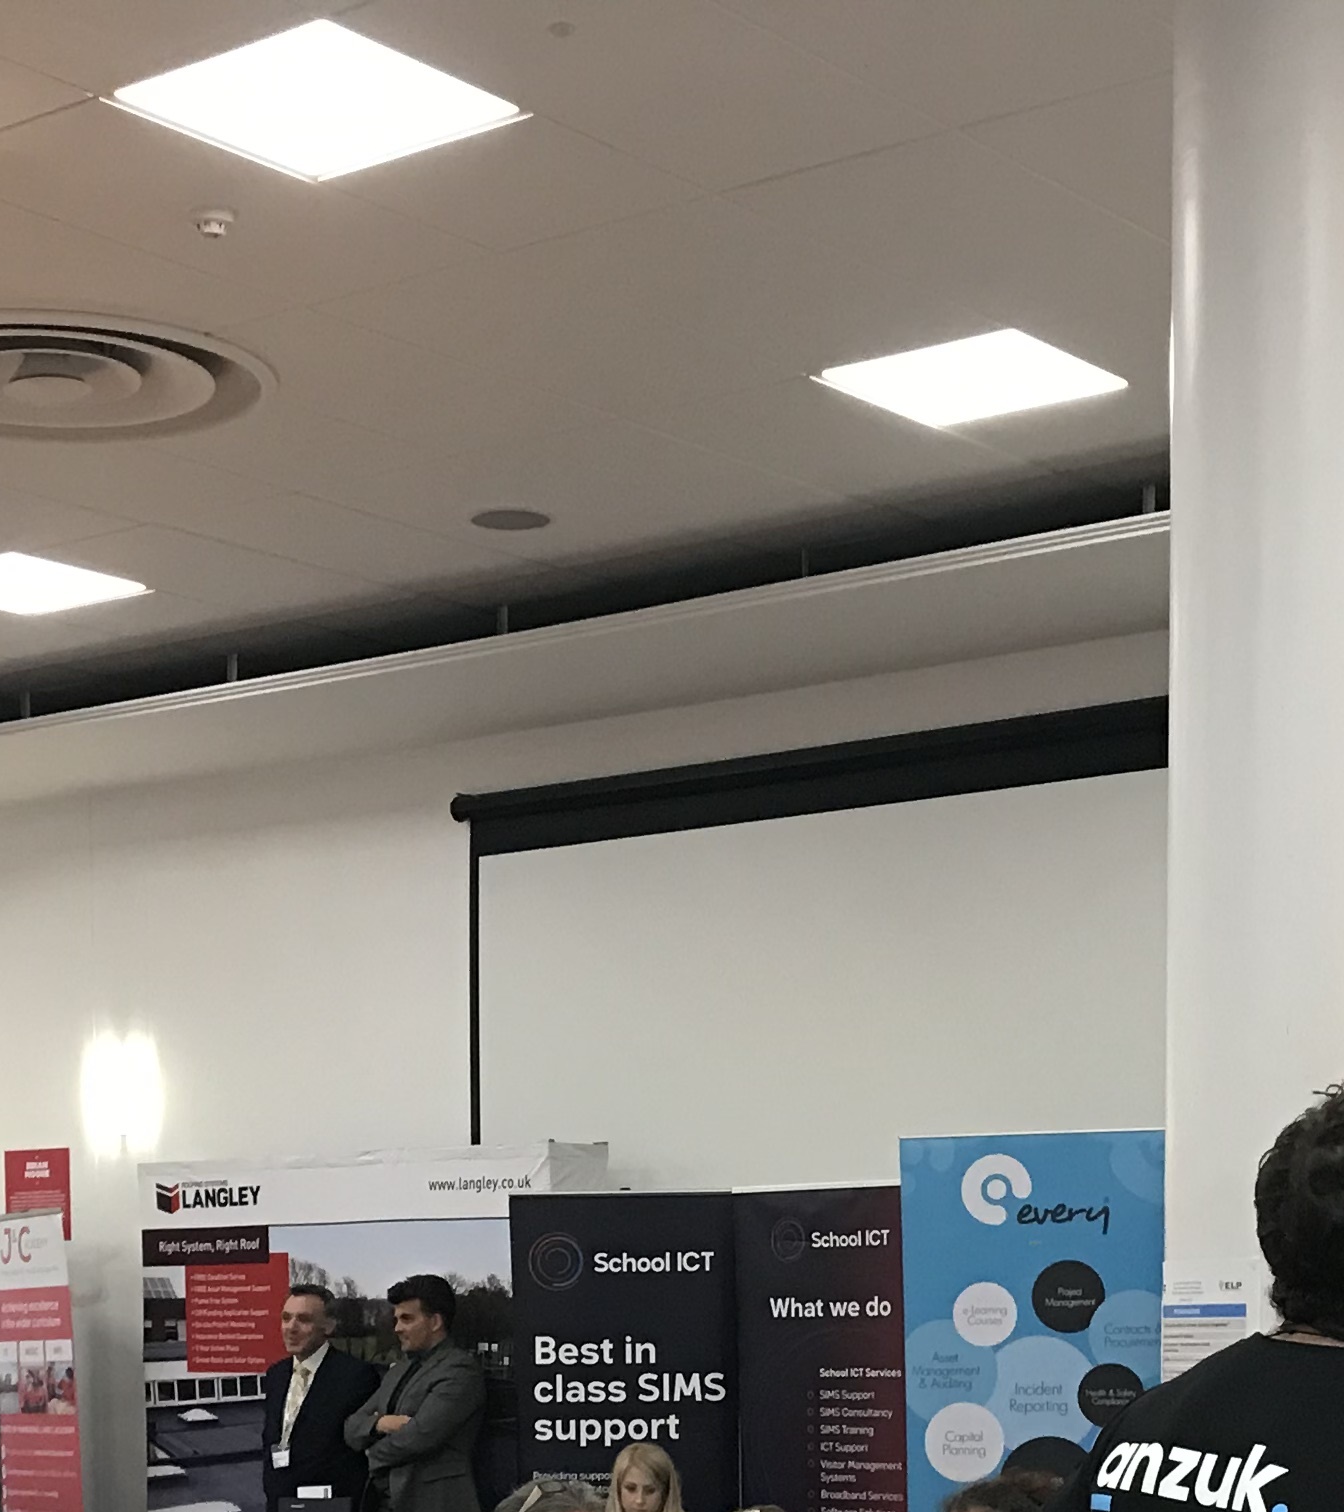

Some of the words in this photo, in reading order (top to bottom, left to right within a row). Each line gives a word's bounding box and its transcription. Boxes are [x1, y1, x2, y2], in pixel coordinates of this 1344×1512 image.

[428, 1175, 531, 1193] www.langley.co.uk
[182, 1185, 260, 1208] LANGLEY
[1016, 1199, 1110, 1235] every
[811, 1231, 861, 1248] School
[865, 1230, 890, 1246] ICT
[159, 1241, 181, 1255] Right
[181, 1240, 215, 1254] System,
[216, 1239, 238, 1253] Right
[240, 1238, 260, 1250] Roof
[593, 1252, 670, 1272] School
[677, 1252, 714, 1271] ICT
[1058, 1287, 1082, 1298] Project
[770, 1297, 823, 1317] What
[829, 1300, 860, 1317] we
[866, 1296, 891, 1317] do
[1045, 1298, 1095, 1308] Management
[967, 1315, 1003, 1326] Courses
[1104, 1324, 1151, 1335] Contracts
[1104, 1336, 1160, 1347] Procuremen
[534, 1335, 613, 1365] Best
[625, 1335, 656, 1364] in
[932, 1352, 958, 1362] Asset
[820, 1368, 848, 1377] School
[850, 1368, 863, 1377] ICT
[865, 1368, 901, 1377] Services
[912, 1365, 980, 1379] Management
[534, 1374, 626, 1402] class
[638, 1372, 726, 1401] SIMS
[930, 1378, 972, 1391] Auditing
[1014, 1382, 1063, 1396] Incident
[820, 1390, 840, 1399] SIMS
[842, 1390, 875, 1400] Support
[820, 1408, 840, 1417] SIMS
[842, 1408, 893, 1419] Consultancy
[1009, 1400, 1068, 1416] Reporting
[534, 1414, 679, 1447] support
[820, 1425, 840, 1434] SIMS
[842, 1425, 874, 1437] Training
[944, 1431, 984, 1445] Capital
[820, 1442, 833, 1452] ICT
[835, 1442, 869, 1453] Support
[942, 1444, 987, 1459] Planning
[820, 1460, 846, 1469] Visitor
[848, 1461, 903, 1472] Management
[820, 1472, 856, 1484] Systems
[820, 1490, 867, 1500] Broadband
[868, 1491, 904, 1501] Services
